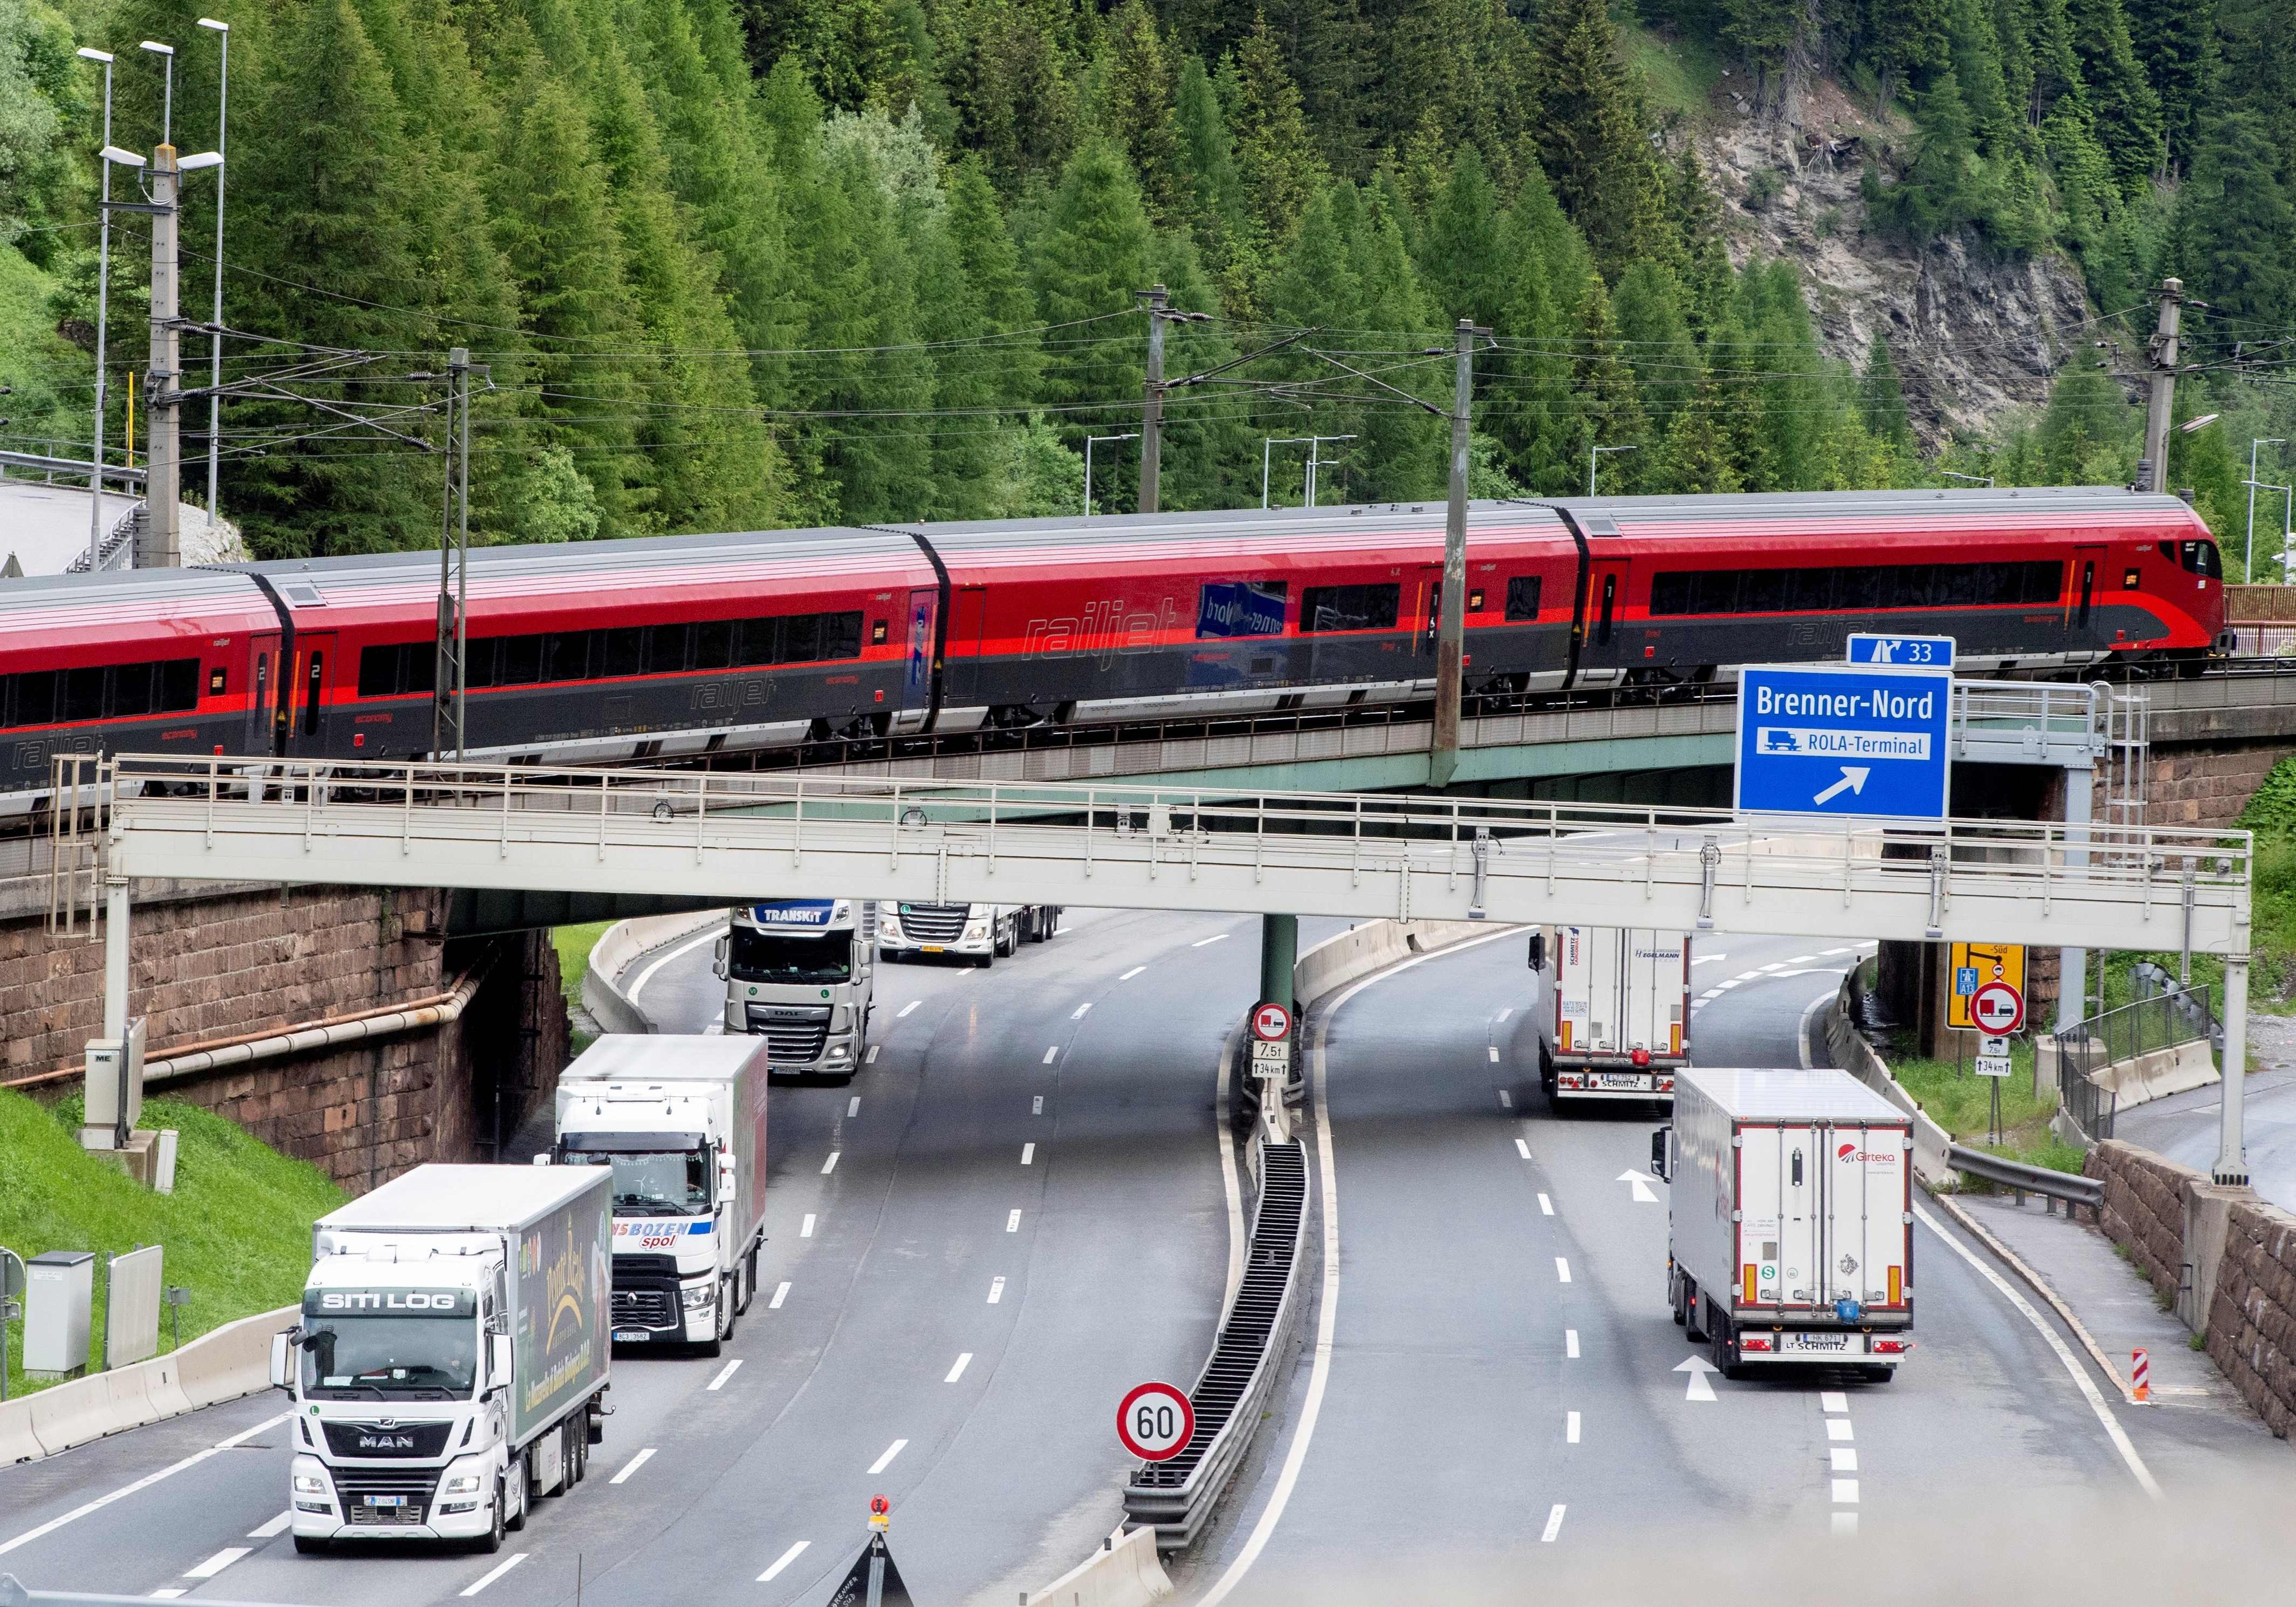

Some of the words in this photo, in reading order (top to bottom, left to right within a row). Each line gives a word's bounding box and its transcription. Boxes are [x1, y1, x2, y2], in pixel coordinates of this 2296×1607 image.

[1607, 586, 1612, 597] 1
[1433, 594, 1438, 605] 1
[1021, 597, 1176, 671] railjet
[1909, 643, 1932, 662] 33
[259, 667, 266, 680] 2
[311, 665, 321, 678] 2
[691, 671, 777, 715] railjet
[1757, 686, 1933, 719] Brenner-Nord
[1809, 734, 1922, 754] ROLA-Terminal
[1961, 984, 1974, 993] A13
[1260, 1063, 1269, 1074] 34
[1271, 1066, 1280, 1074] km
[1983, 1061, 1992, 1071] 34
[1994, 1063, 2004, 1072] km
[1856, 1152, 1895, 1162] Girteka
[629, 1223, 689, 1236] BOZEN
[642, 1235, 676, 1249] spol
[1763, 1266, 1773, 1279] S
[323, 1294, 380, 1309] SITI
[387, 1294, 455, 1309] LOG
[312, 1407, 317, 1415] L
[1137, 1406, 1174, 1439] 60
[359, 1437, 413, 1447] MAN
